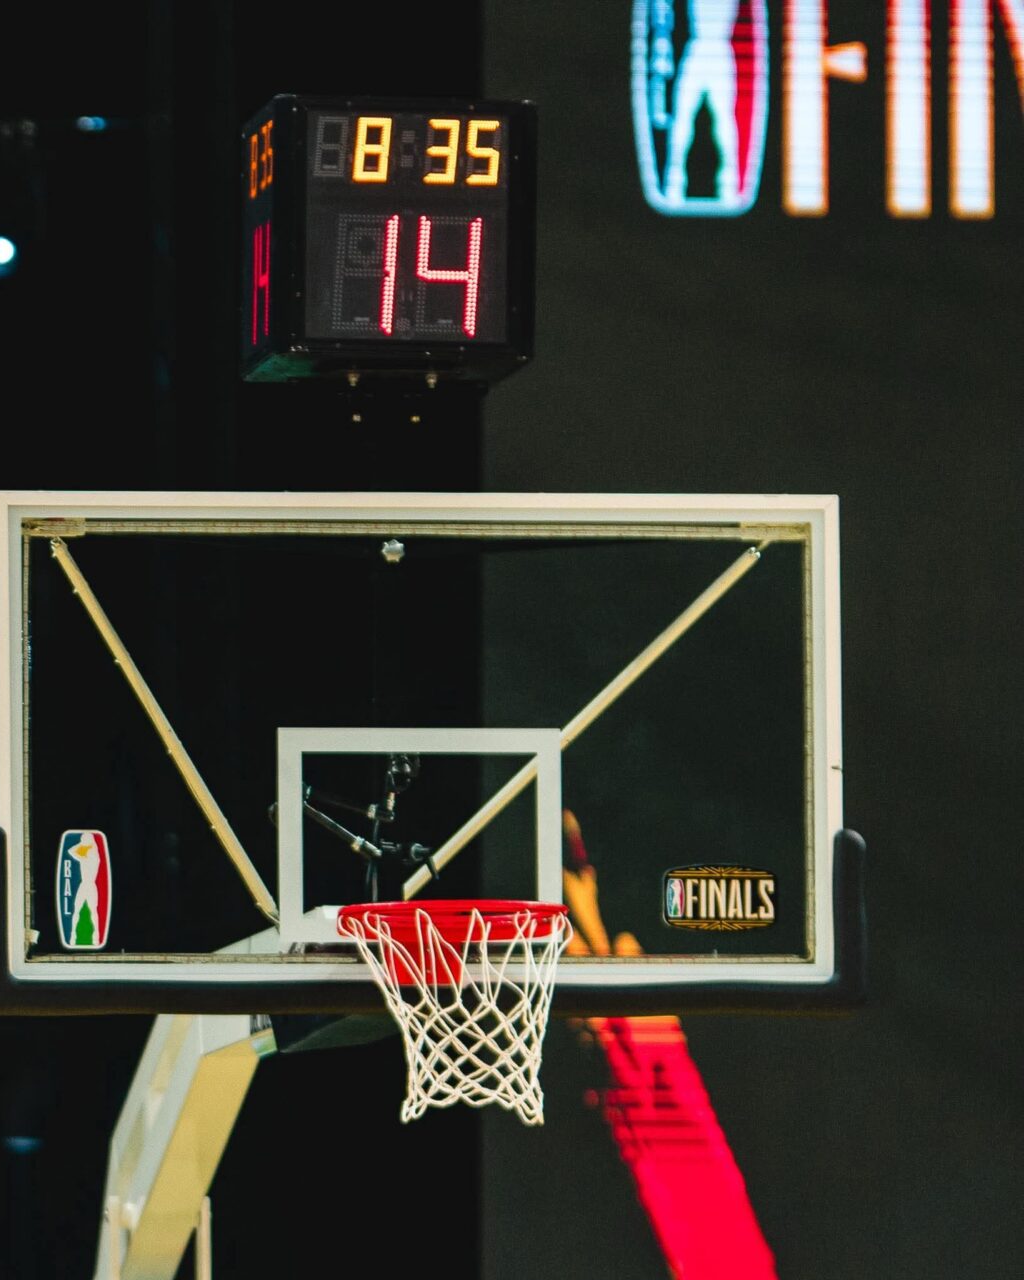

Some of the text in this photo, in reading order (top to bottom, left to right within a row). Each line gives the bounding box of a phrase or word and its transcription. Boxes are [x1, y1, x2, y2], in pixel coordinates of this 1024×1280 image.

[380, 213, 483, 338] 14
[63, 859, 73, 915] BAL
[685, 879, 775, 919] FINALS
